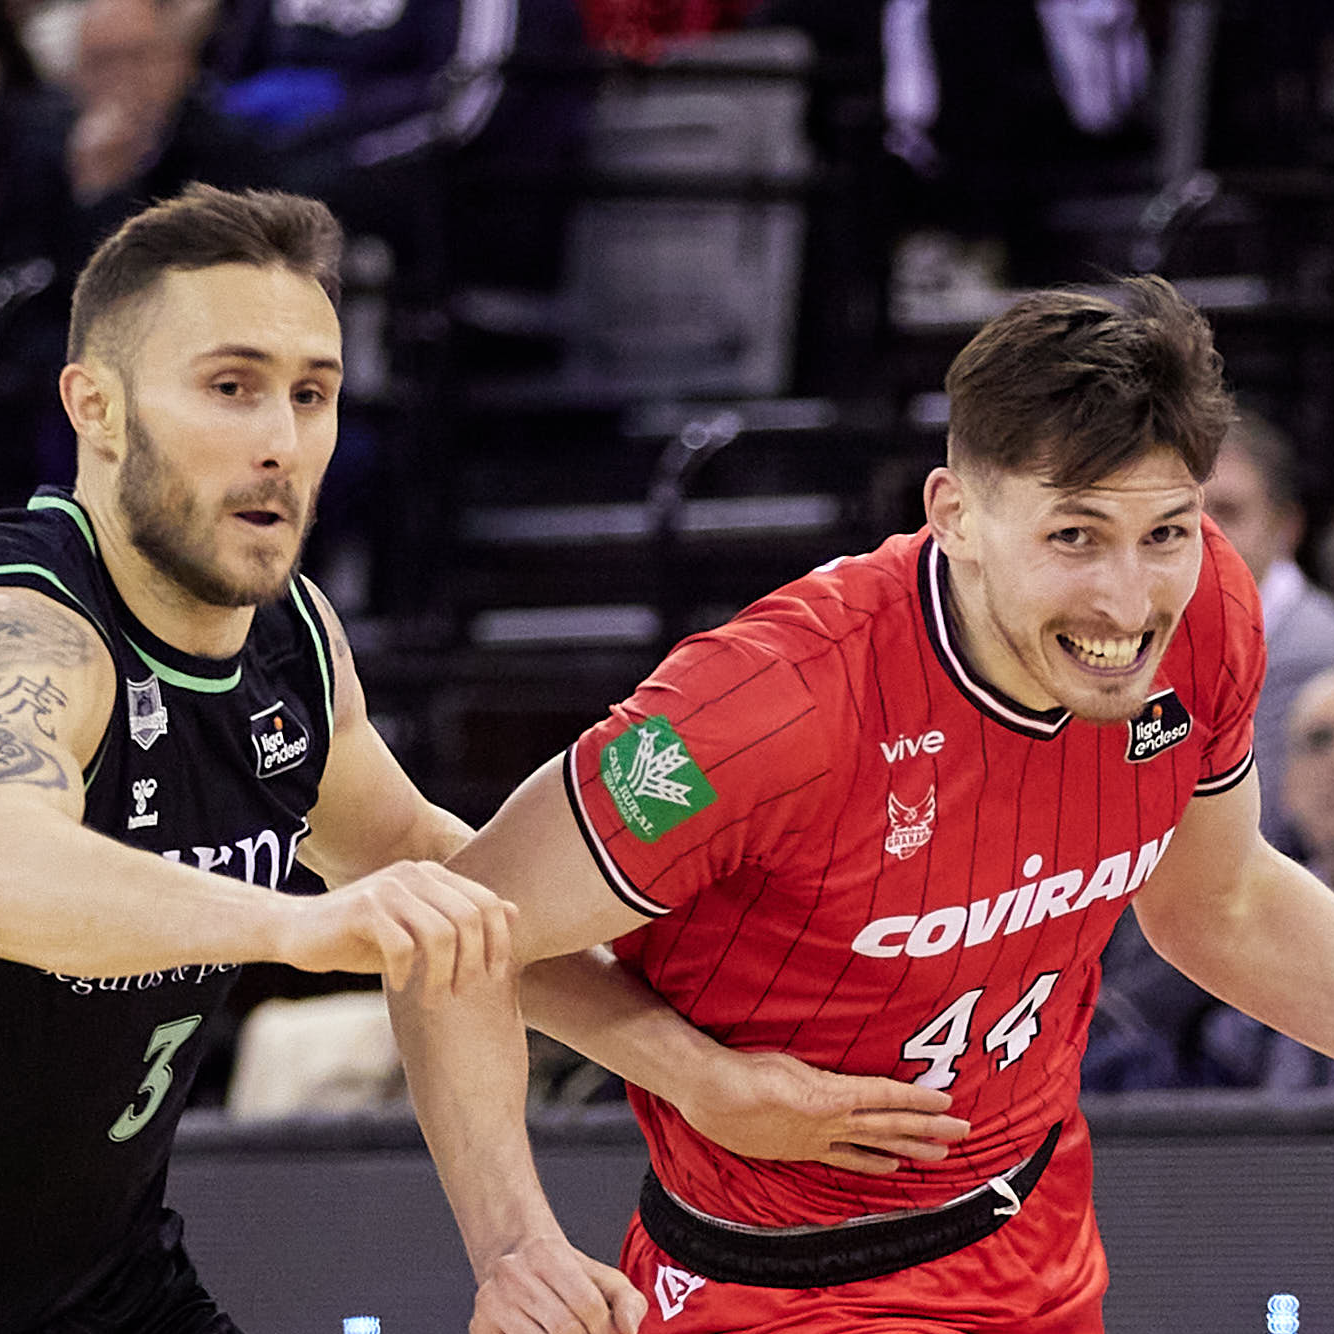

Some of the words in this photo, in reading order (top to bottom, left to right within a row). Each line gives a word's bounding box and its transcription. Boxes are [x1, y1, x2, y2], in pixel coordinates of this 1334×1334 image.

[880, 730, 945, 763] vive
[1134, 722, 1188, 756] endesa
[1136, 719, 1162, 741] liga
[900, 970, 1063, 1092] 44
[108, 1014, 203, 1143] 3
